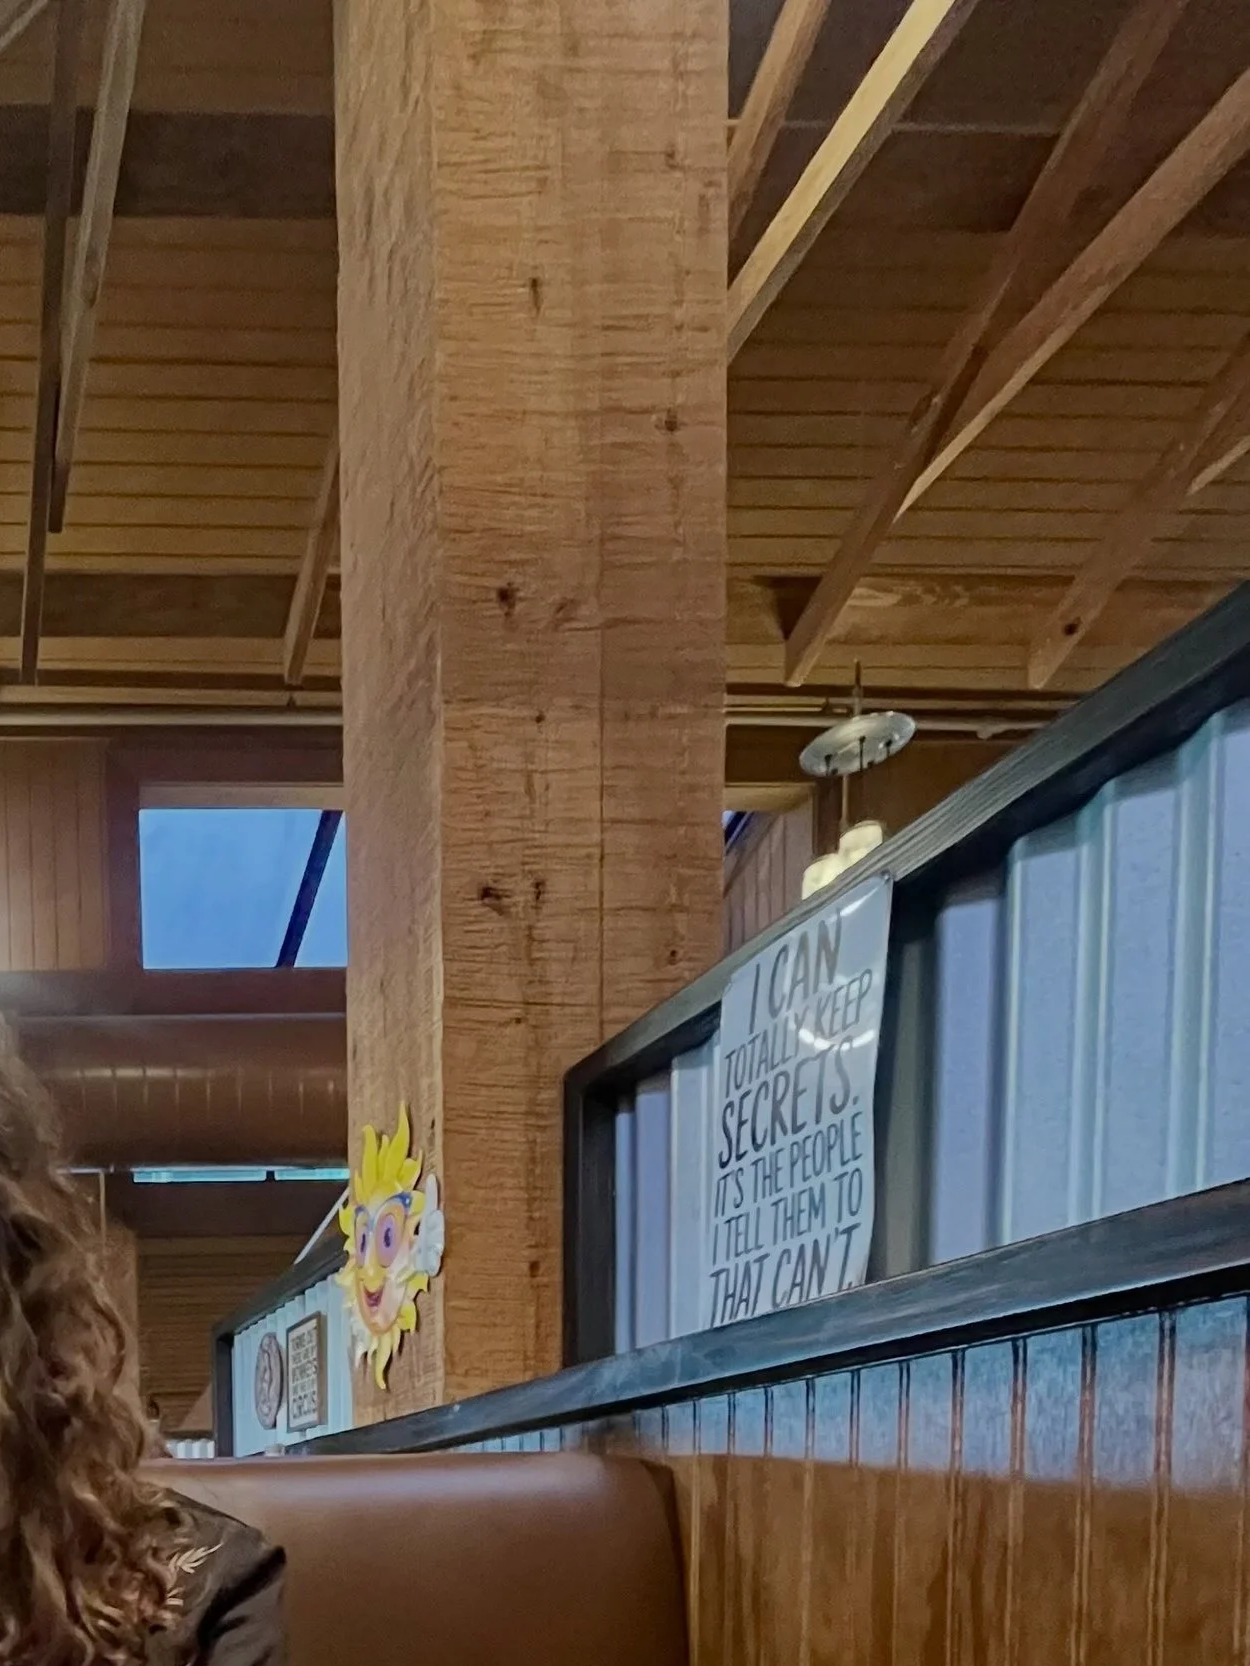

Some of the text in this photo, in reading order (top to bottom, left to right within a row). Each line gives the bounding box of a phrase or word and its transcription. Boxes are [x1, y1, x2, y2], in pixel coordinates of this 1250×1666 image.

[750, 909, 842, 1036] I CAN
[725, 968, 873, 1099] TOTALLY KEEP
[719, 1036, 859, 1168] SECRETS.
[713, 1168, 863, 1266] I TELL THEM TO
[715, 1112, 863, 1218] IT'S THE PEOPLE
[710, 1253, 770, 1328] THAT
